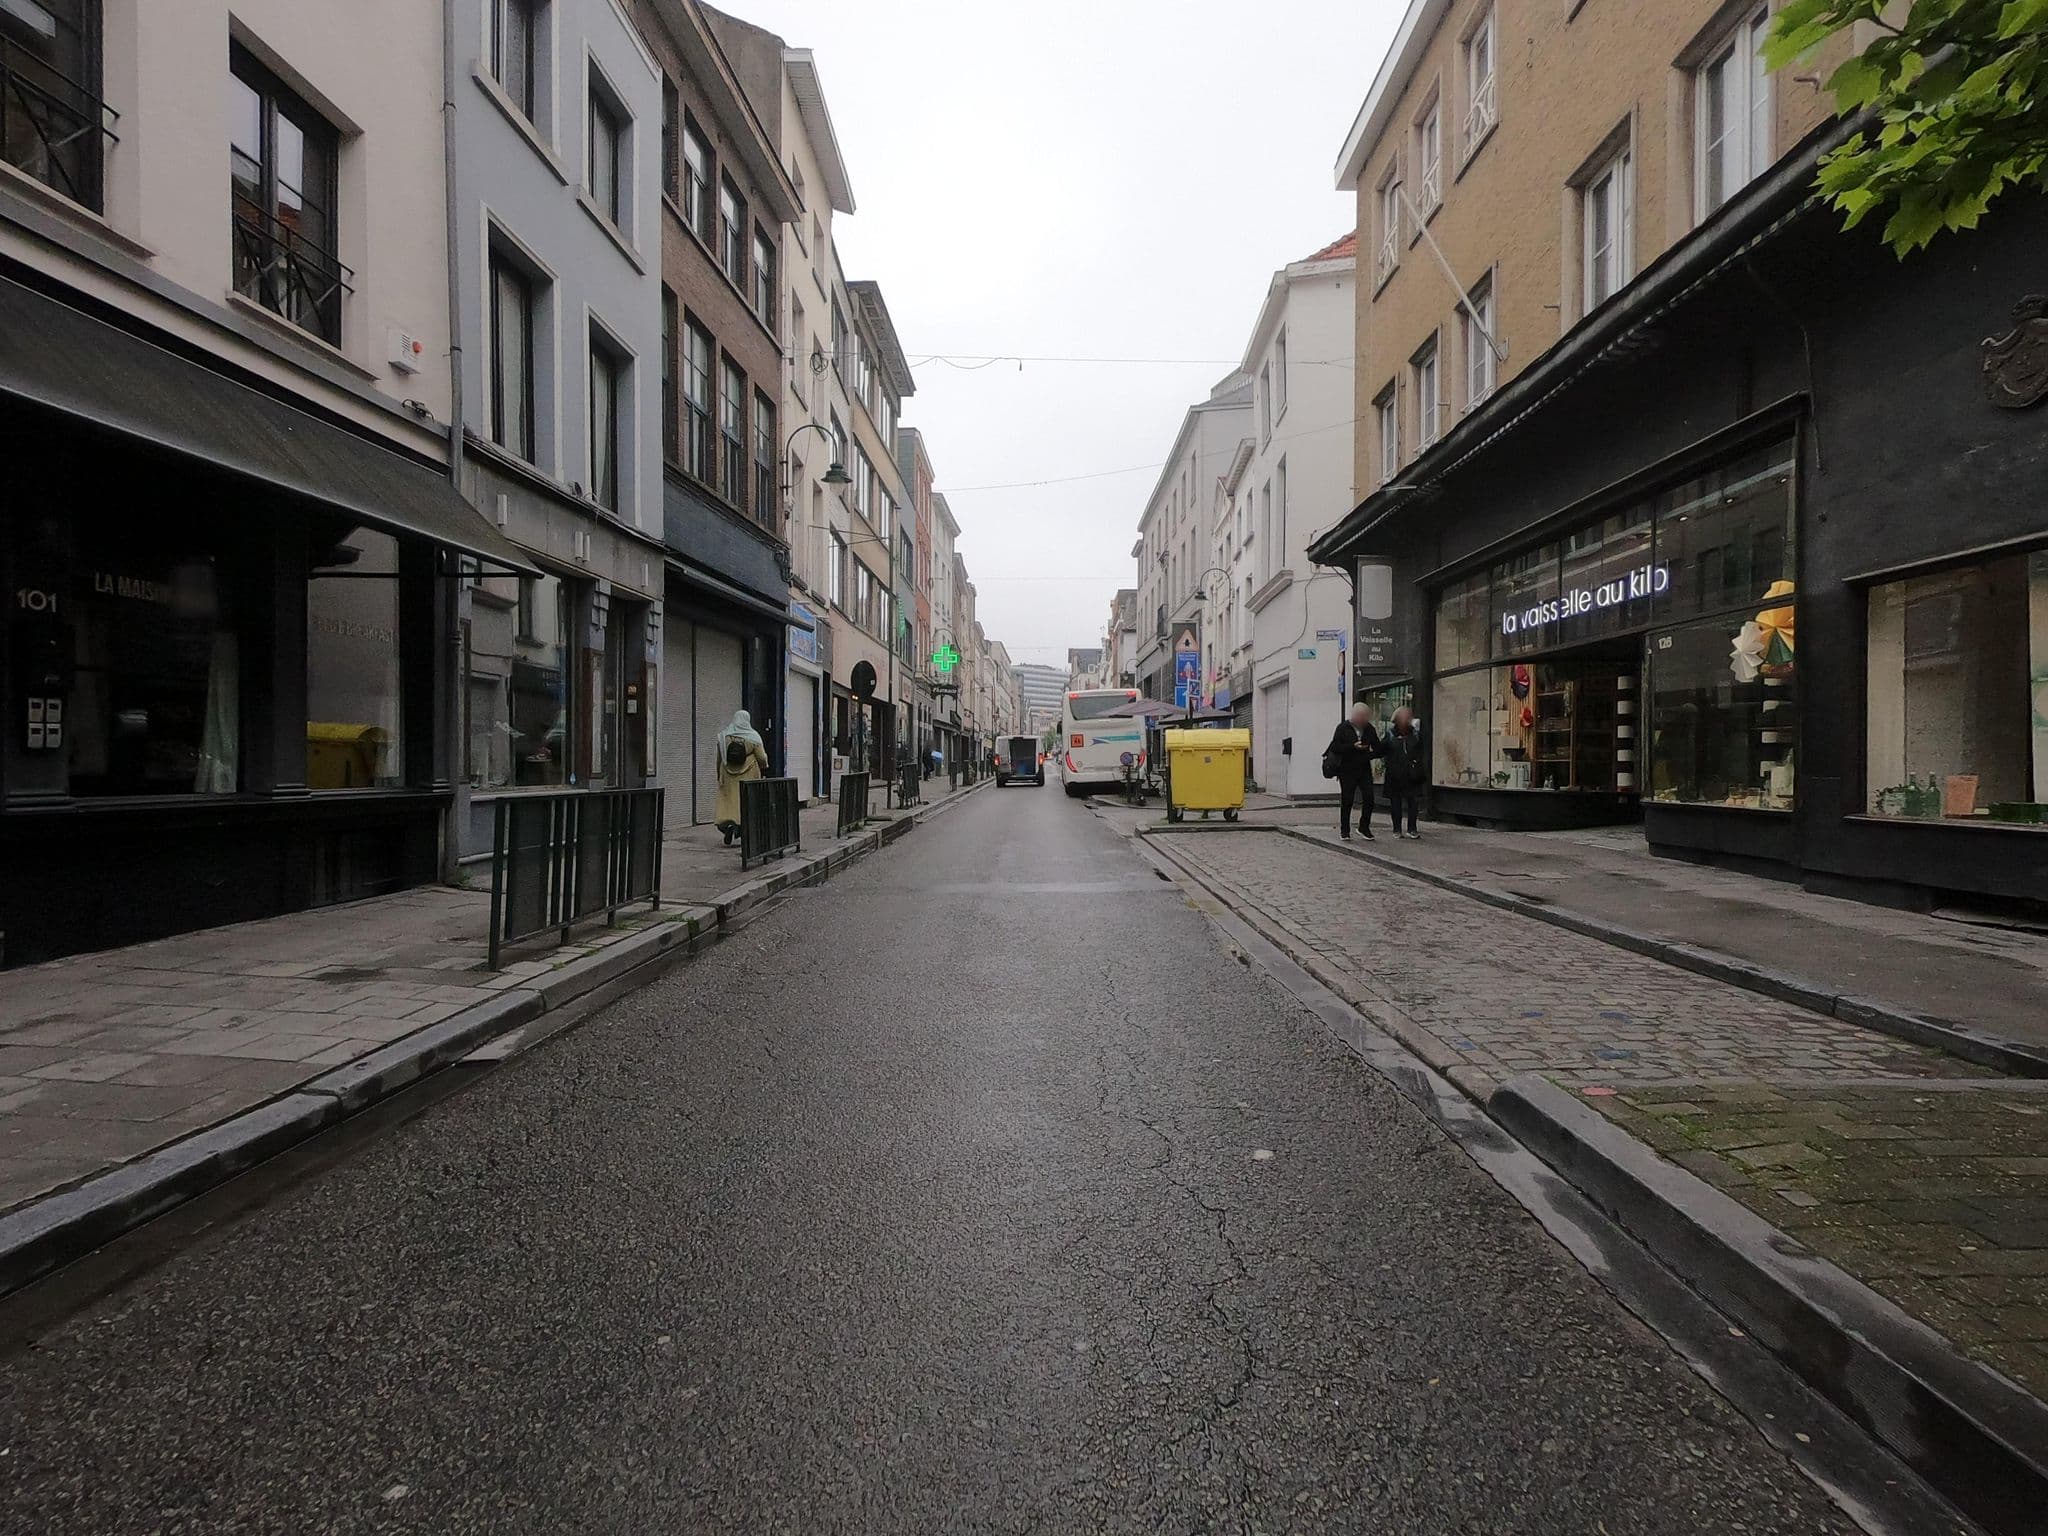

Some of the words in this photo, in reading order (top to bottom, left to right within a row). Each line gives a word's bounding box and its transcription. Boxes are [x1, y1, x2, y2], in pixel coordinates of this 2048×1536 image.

[16, 588, 57, 613] 101
[1502, 612, 1517, 635] la
[1521, 588, 1592, 630] vaisselle
[1596, 580, 1625, 608] au
[1629, 566, 1668, 599] kilo
[1371, 626, 1382, 635] La
[1360, 635, 1393, 645] Vaisselle
